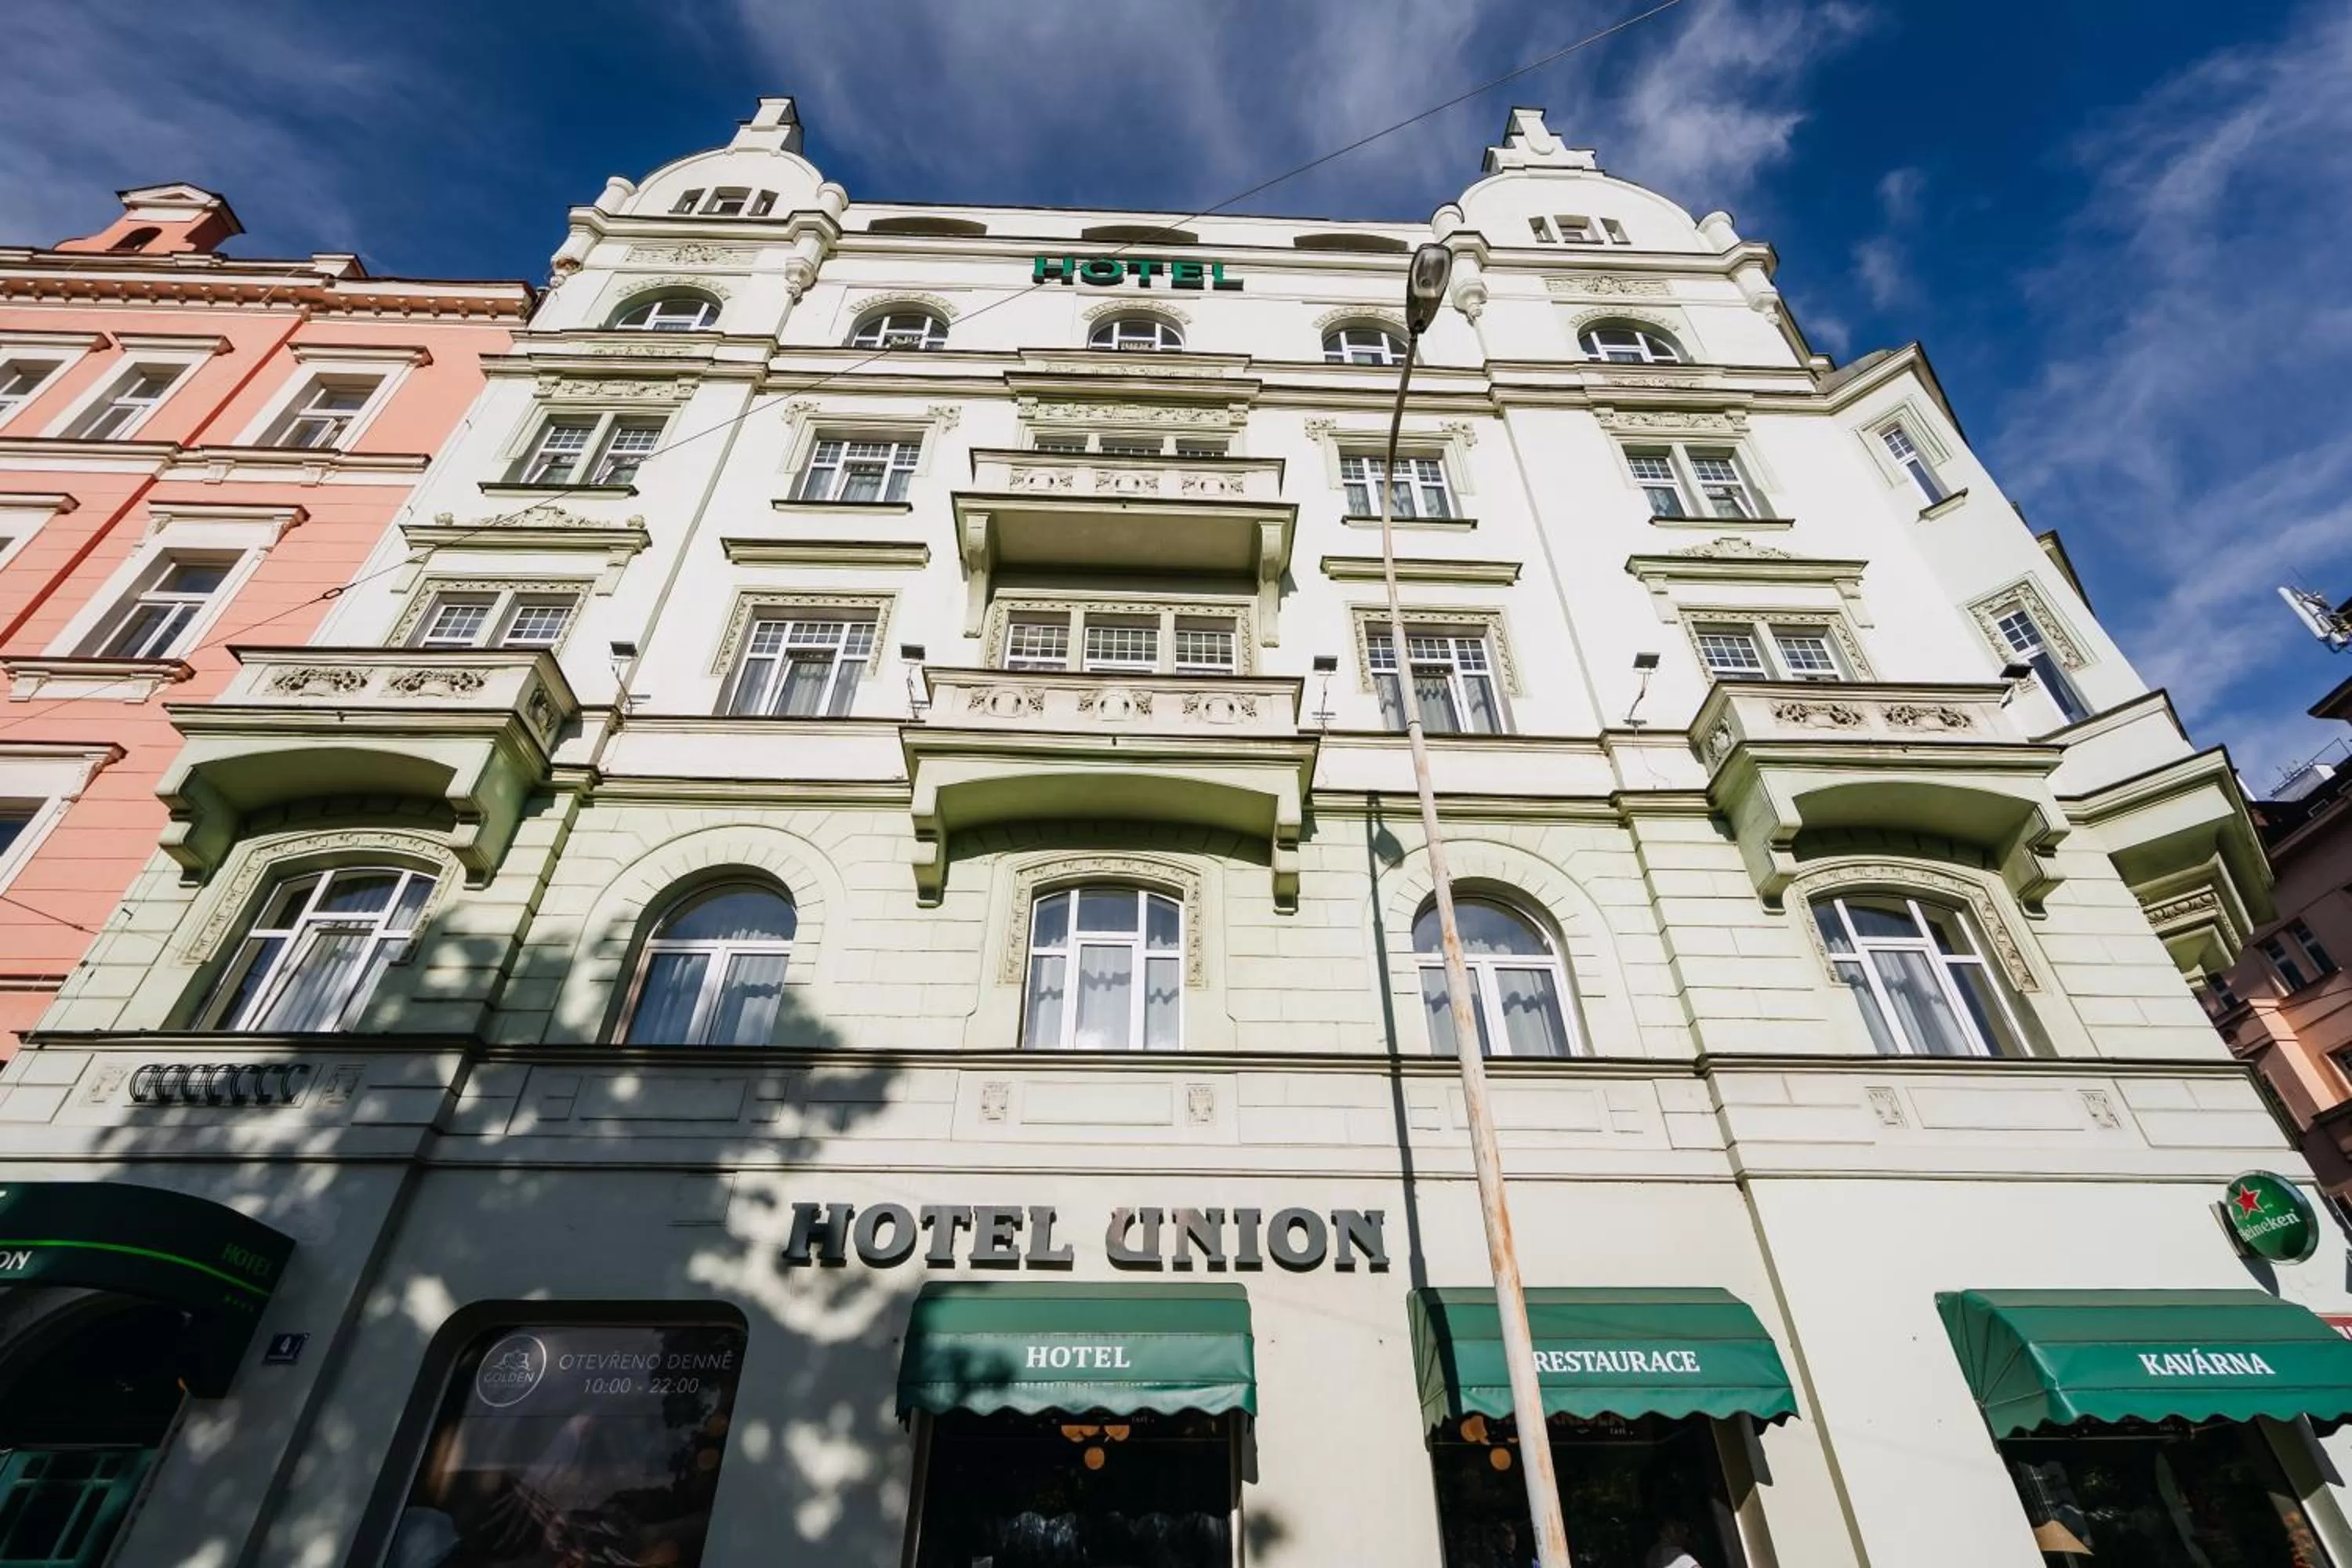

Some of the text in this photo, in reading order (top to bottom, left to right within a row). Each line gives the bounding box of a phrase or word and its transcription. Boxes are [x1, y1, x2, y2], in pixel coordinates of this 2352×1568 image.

[1033, 256, 1243, 290] HOTEL
[783, 1203, 1390, 1272] HOTEL UNION
[2238, 1213, 2301, 1242] Heineken
[559, 1350, 735, 1370] OTEVŘENO DENNĚ
[1025, 1345, 1131, 1368] HOTEL
[1533, 1351, 1700, 1372] RESTAURACE
[2138, 1348, 2276, 1376] KAVÁRNA
[483, 1371, 535, 1384] GOLDEN
[583, 1377, 631, 1393] 10:00
[649, 1377, 699, 1393] 22:00
